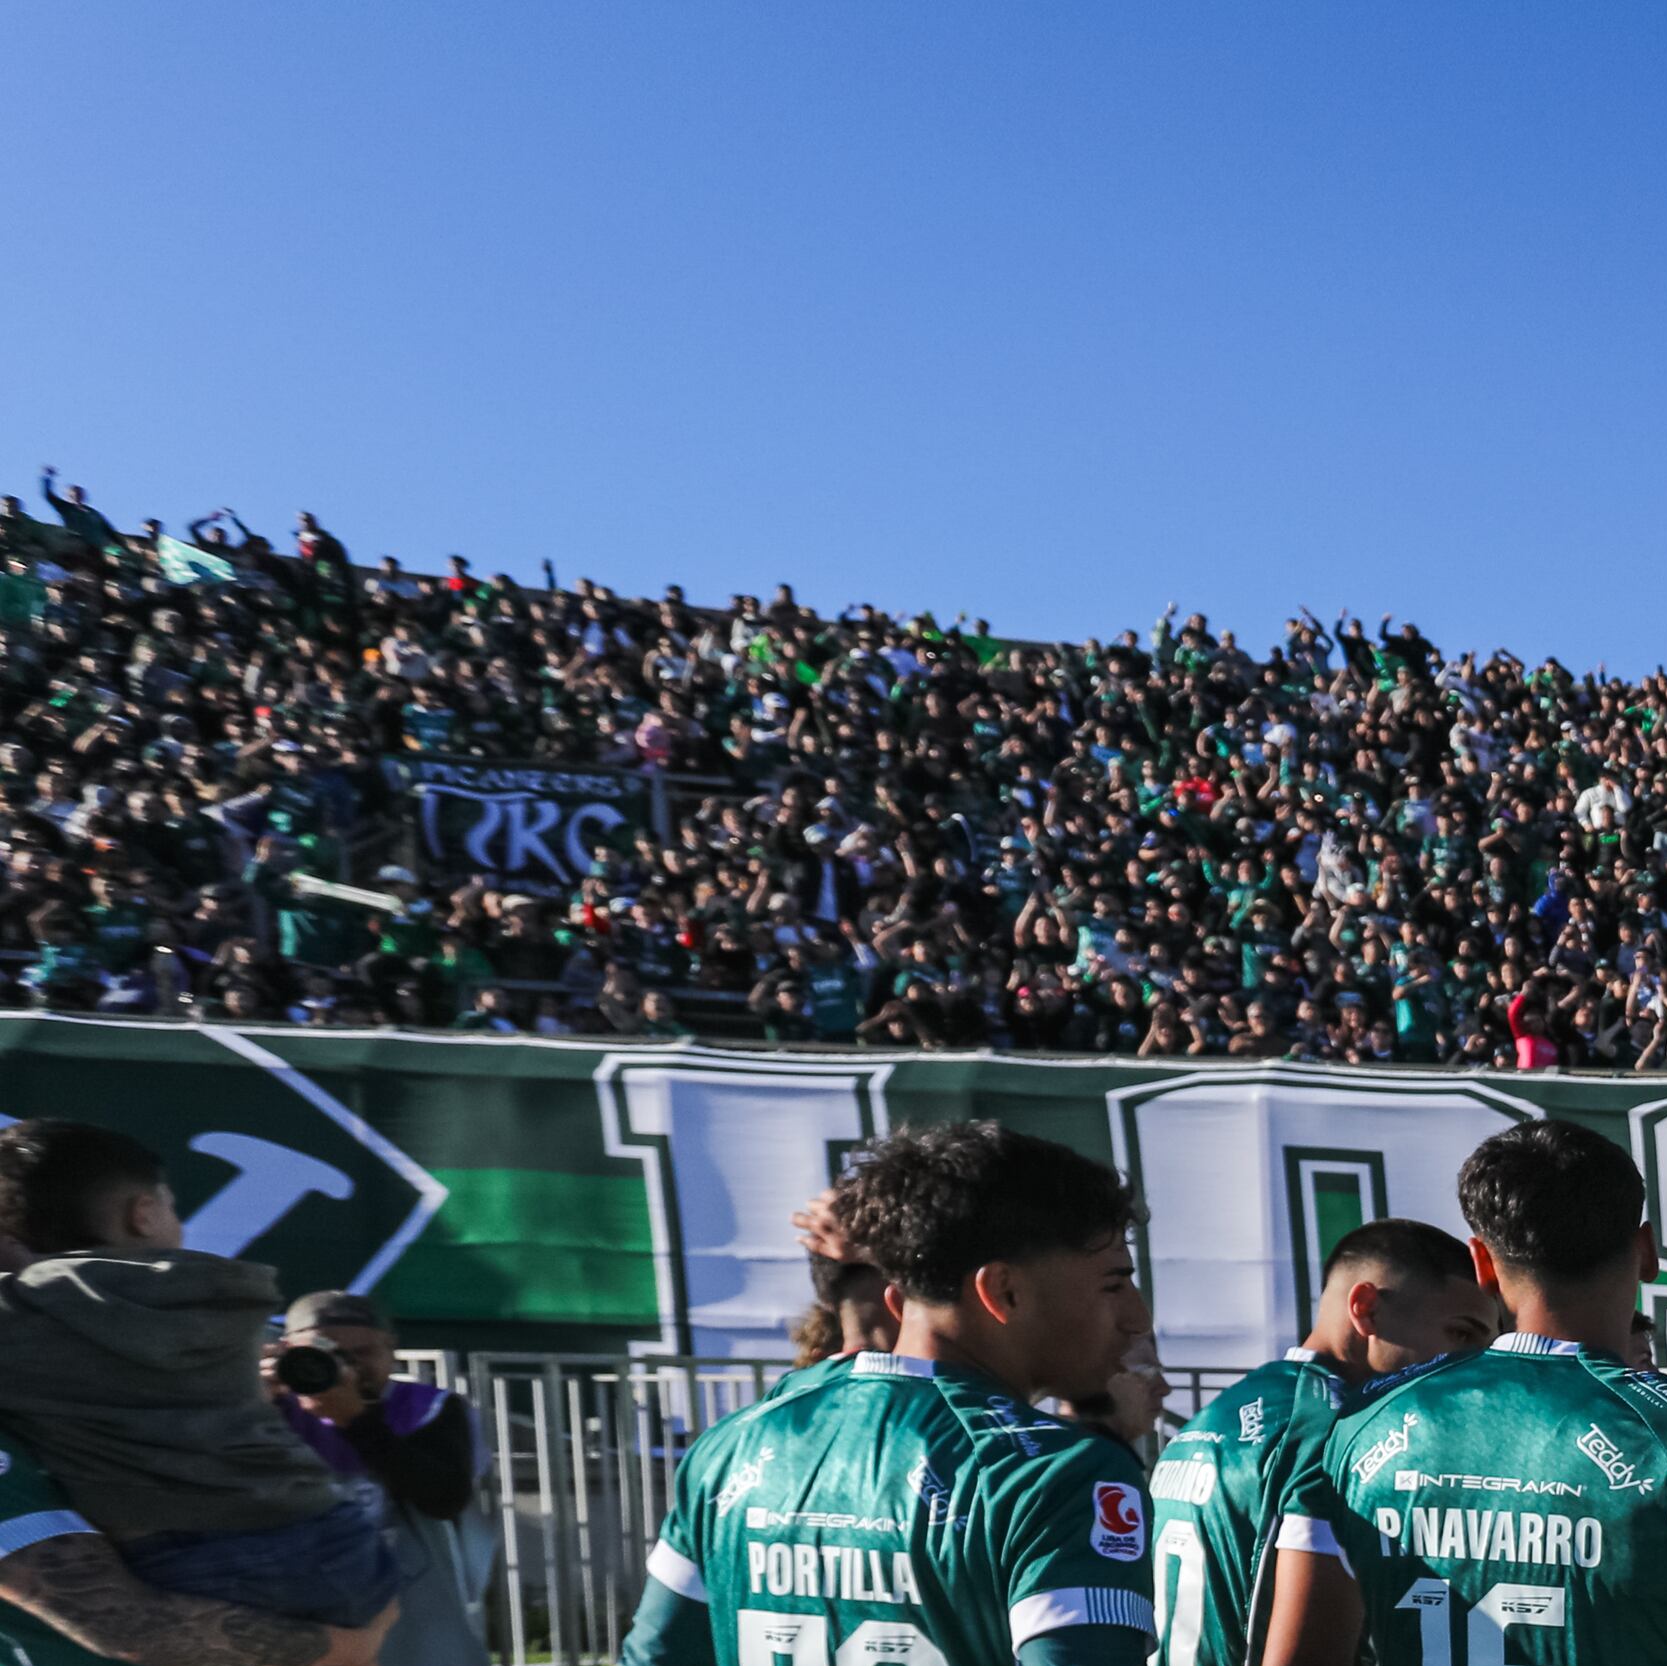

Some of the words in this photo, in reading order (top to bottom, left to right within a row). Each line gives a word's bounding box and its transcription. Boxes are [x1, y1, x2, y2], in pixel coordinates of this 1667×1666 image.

[1352, 1421, 1412, 1484] Teddy
[1577, 1423, 1642, 1492] Teddy
[1419, 1474, 1582, 1497] INTEGRAKIN
[747, 1541, 923, 1606] PORTILLA
